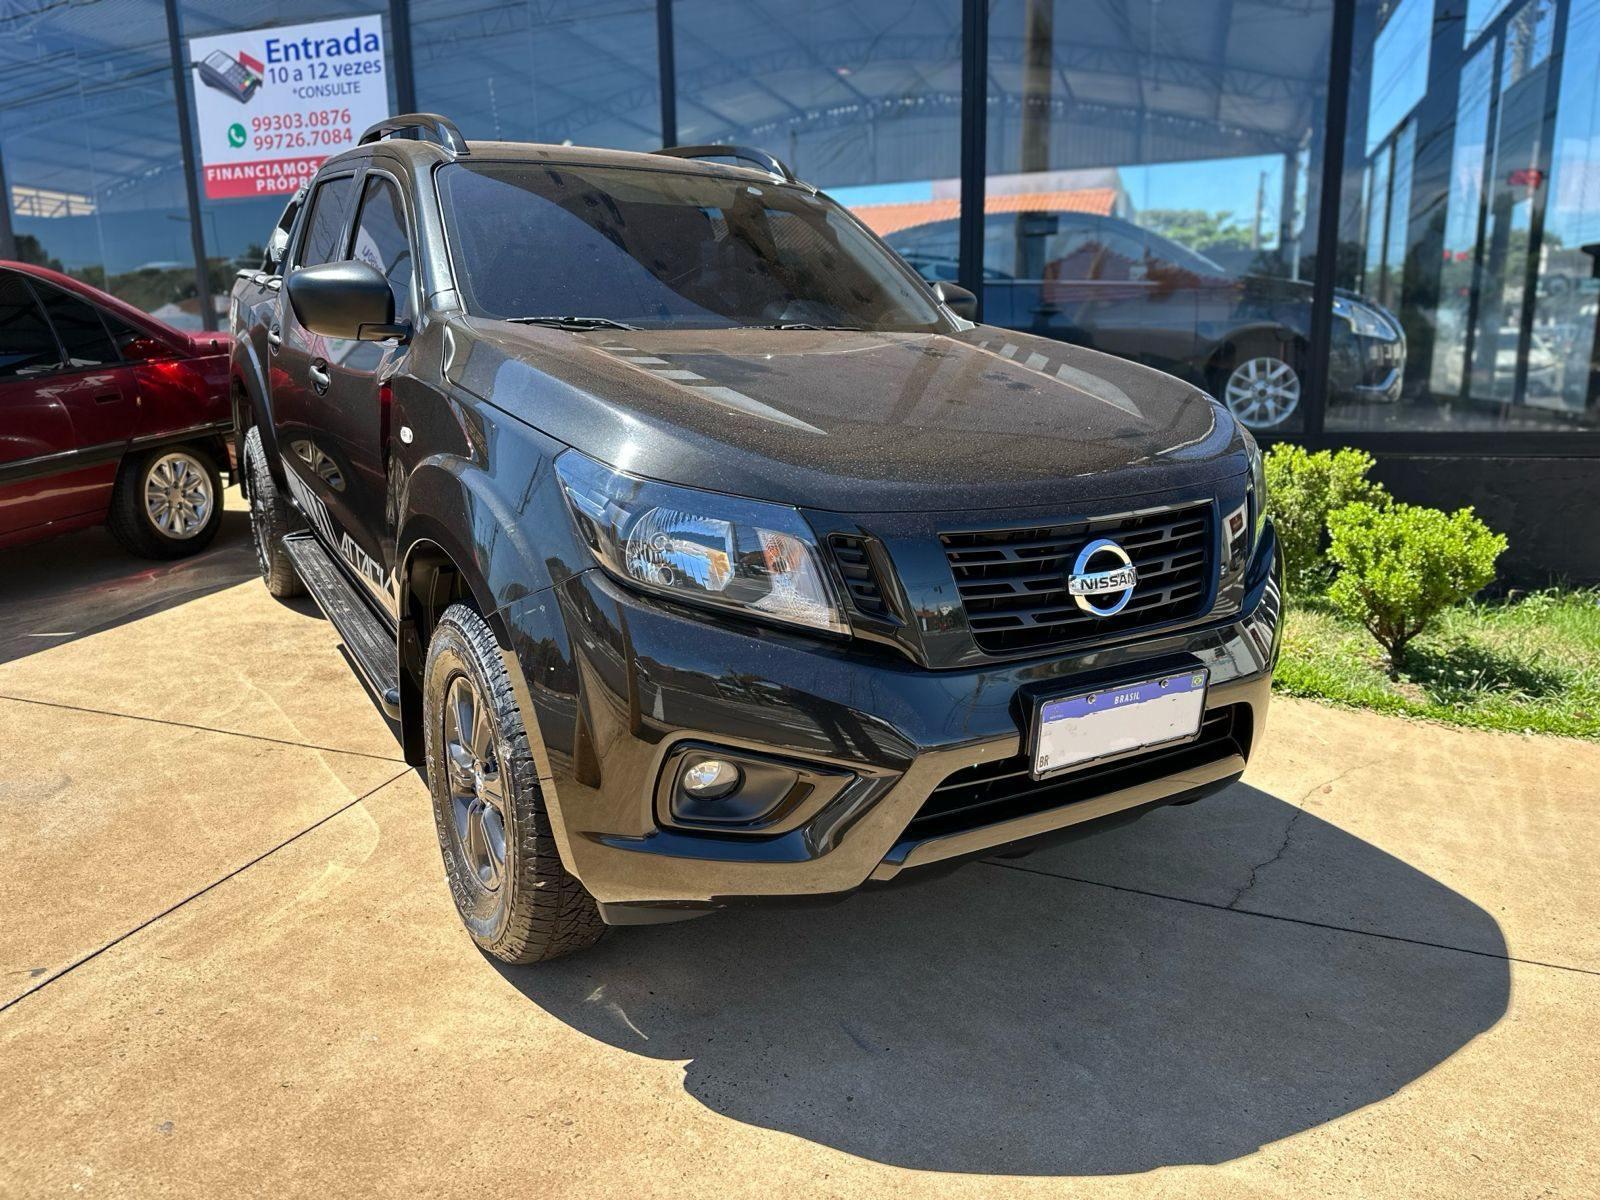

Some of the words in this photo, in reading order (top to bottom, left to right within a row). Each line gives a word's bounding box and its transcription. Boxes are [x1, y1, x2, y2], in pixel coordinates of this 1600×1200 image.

[265, 27, 380, 64] Entrada
[268, 67, 289, 84] 10
[293, 70, 303, 82] a
[310, 63, 329, 80] 12
[333, 59, 382, 77] vezes
[252, 109, 351, 132] 99303.0876
[254, 128, 353, 151] 99726.7084
[207, 160, 318, 181] FINANCIAMOS
[1080, 569, 1138, 591] NISSAN
[1114, 692, 1141, 705] BRASIL
[1039, 755, 1050, 769] BR
